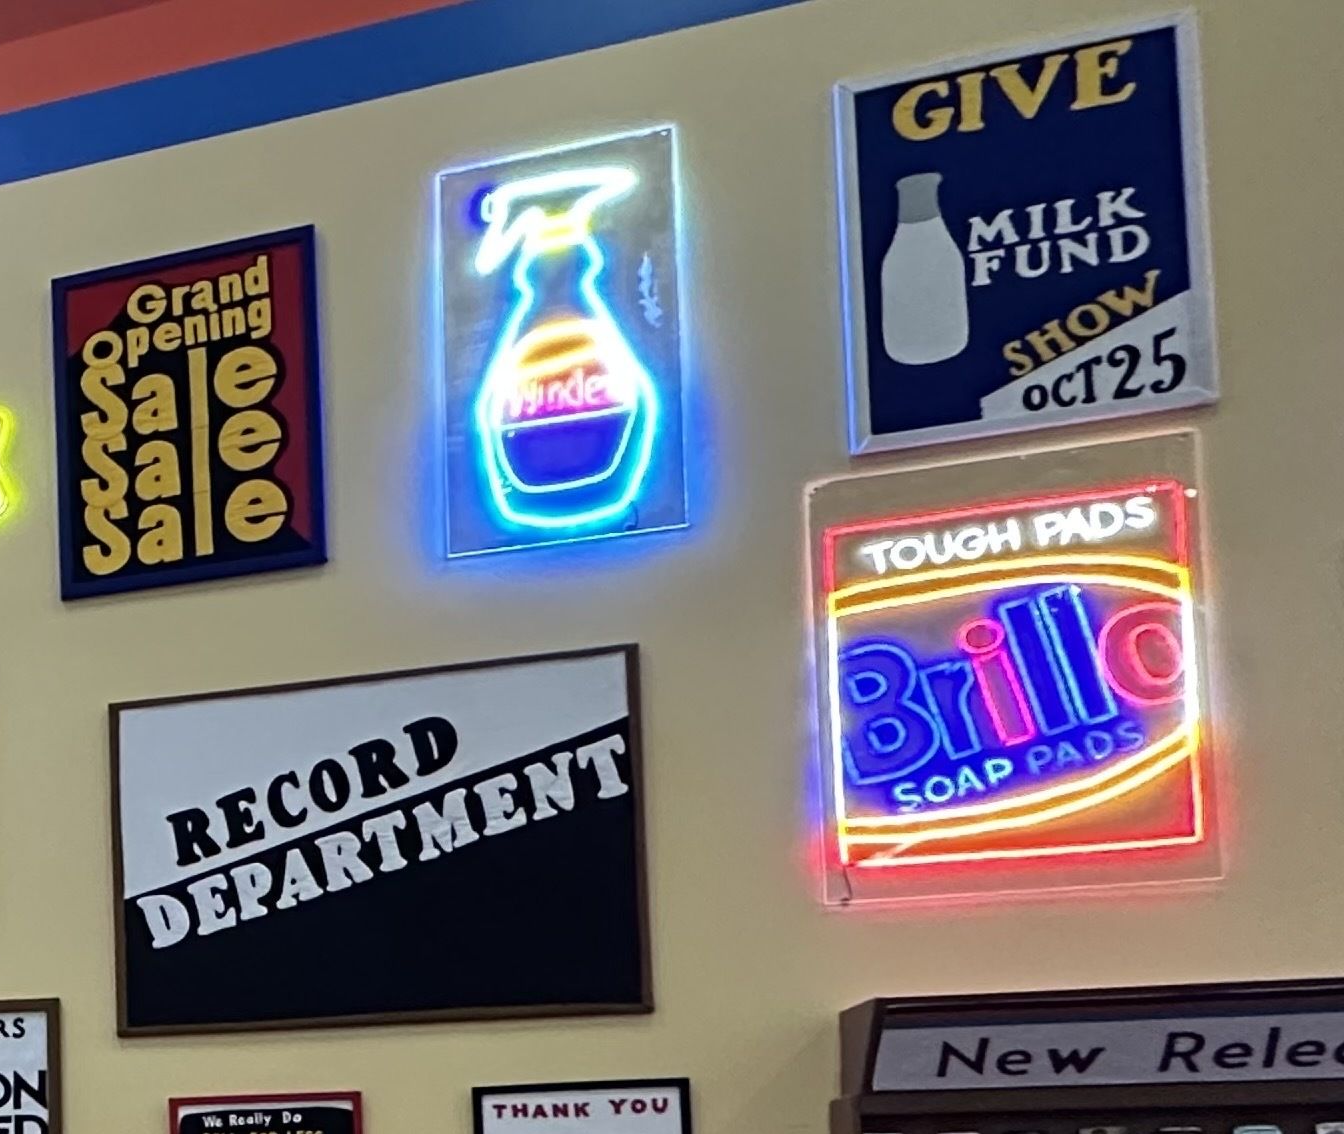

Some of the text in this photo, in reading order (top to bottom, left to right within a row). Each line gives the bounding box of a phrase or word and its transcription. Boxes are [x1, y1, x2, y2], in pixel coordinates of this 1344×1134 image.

[891, 38, 1138, 142] GIVE
[967, 186, 1147, 252] MILK
[968, 223, 1152, 287] FUND
[81, 297, 272, 368] Opening
[126, 255, 270, 324] Grand
[1001, 268, 1162, 378] SHOW
[80, 346, 278, 441] Sale
[1107, 326, 1187, 401] 25
[80, 409, 282, 508] Sale
[82, 478, 288, 576] Sale
[861, 495, 1157, 576] TOUGH PADS
[839, 582, 1187, 786] Brillo
[166, 716, 459, 868] RECORD
[892, 721, 1146, 814] SOAP PADS
[136, 733, 629, 950] DEPARTMENT
[936, 1025, 1344, 1079] New Rele
[201, 1110, 303, 1128] We Really Do
[491, 1097, 669, 1120] THANK YOU
